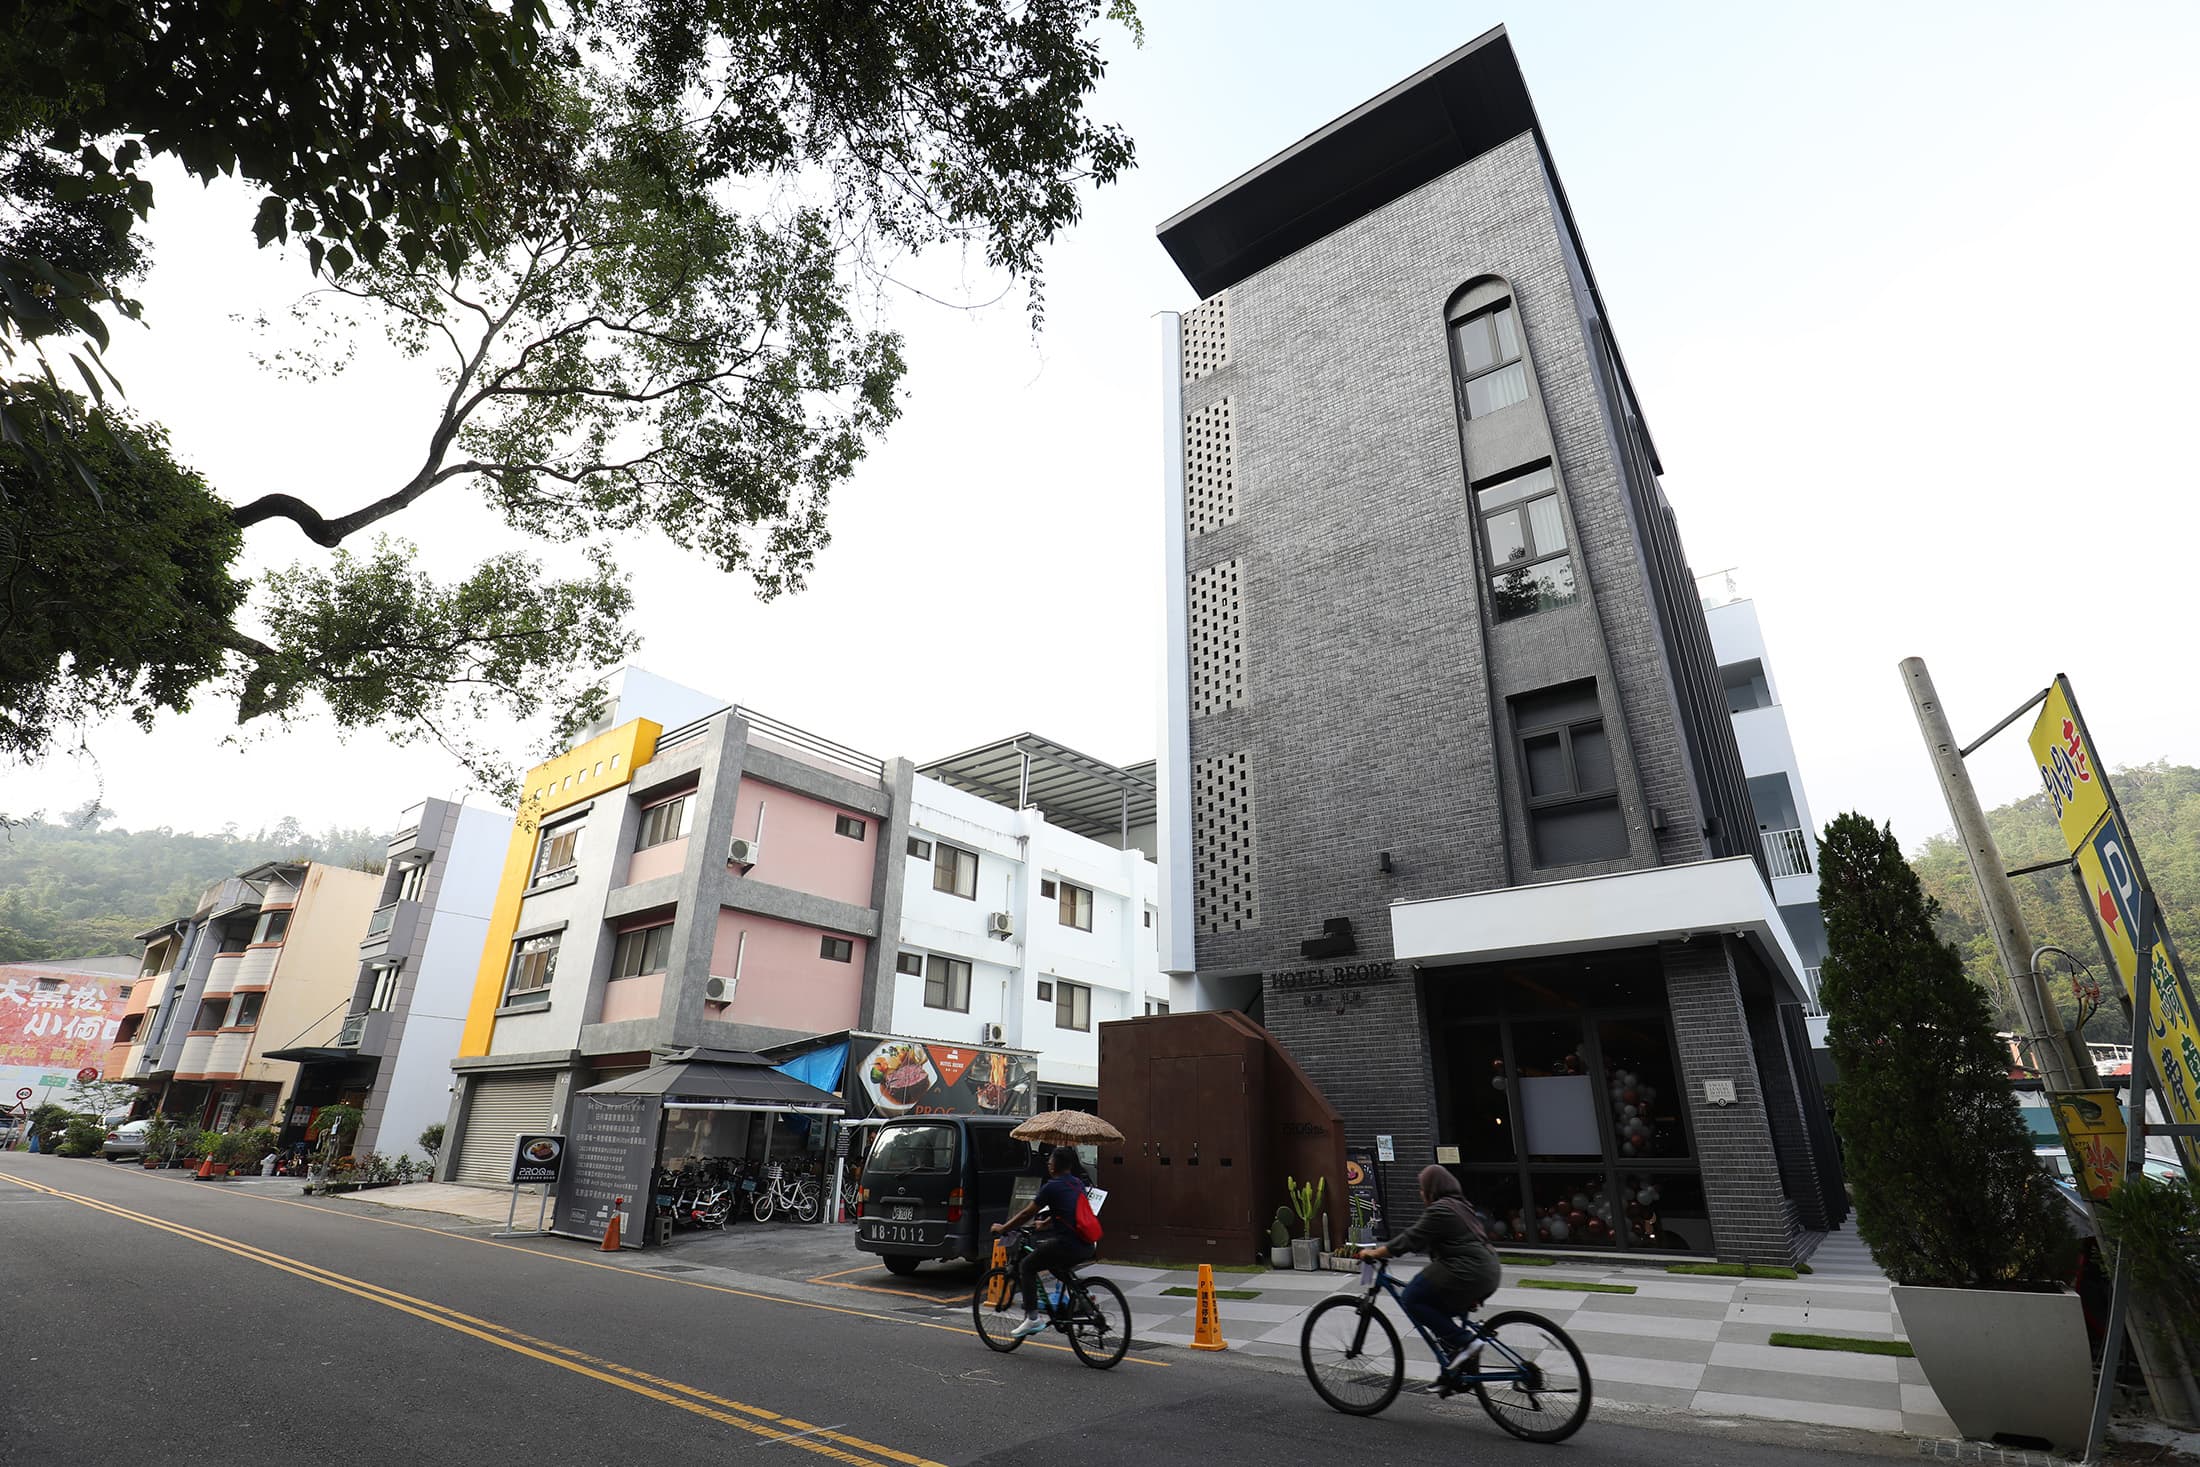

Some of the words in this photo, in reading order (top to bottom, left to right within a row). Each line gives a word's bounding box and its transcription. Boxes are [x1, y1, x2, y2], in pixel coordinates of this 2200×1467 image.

[2103, 840, 2139, 939] P
[1271, 970, 1329, 988] HOTEL
[1333, 962, 1394, 984] BEORE
